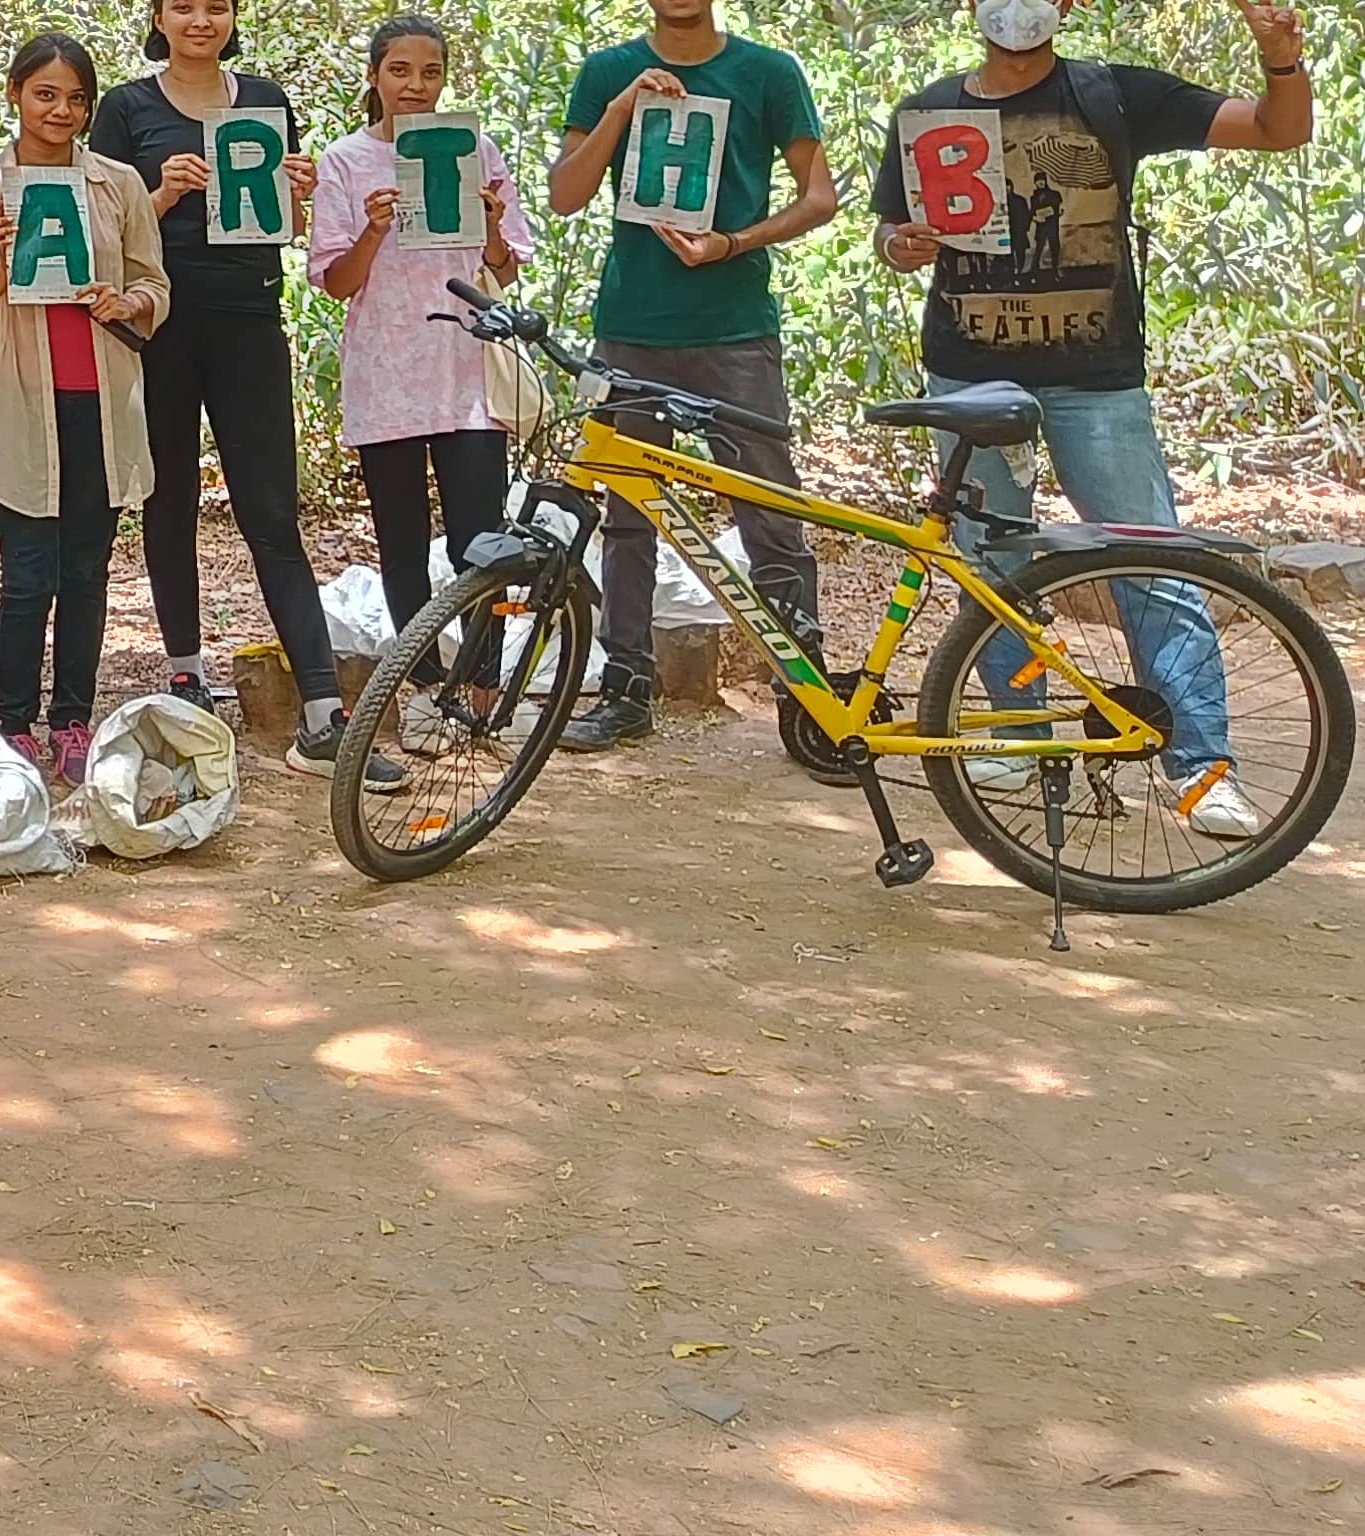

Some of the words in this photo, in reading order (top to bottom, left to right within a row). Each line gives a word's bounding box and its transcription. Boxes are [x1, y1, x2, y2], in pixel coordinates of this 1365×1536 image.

[214, 119, 284, 236] R
[396, 126, 477, 234] T
[634, 108, 715, 213] H
[913, 124, 995, 235] B
[10, 183, 92, 286] A
[1000, 299, 1032, 313] THE
[641, 497, 802, 661] ROADEO
[924, 742, 1006, 755] ROADEO
